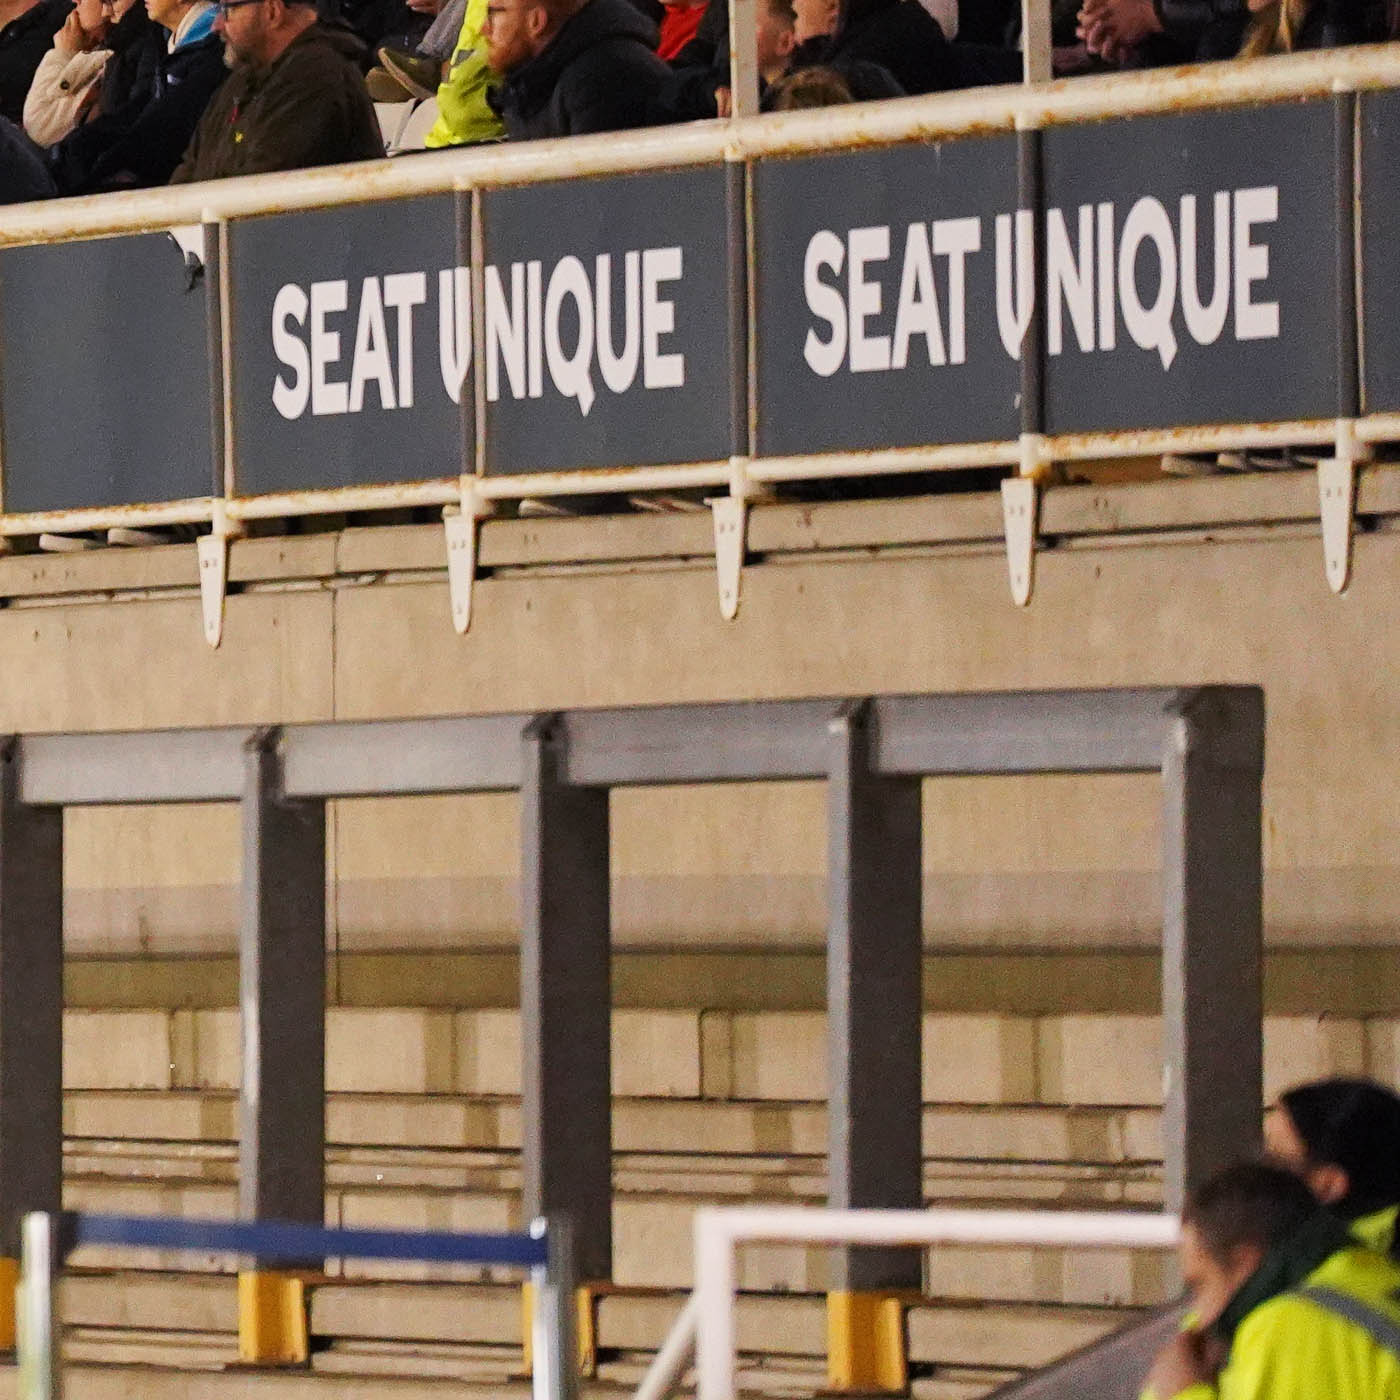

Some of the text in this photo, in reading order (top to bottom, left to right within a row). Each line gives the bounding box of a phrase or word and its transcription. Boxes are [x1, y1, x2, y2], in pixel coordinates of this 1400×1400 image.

[272, 247, 685, 421] SEAT UNIQUE
[803, 185, 1280, 378] SEAT UNIQUE
